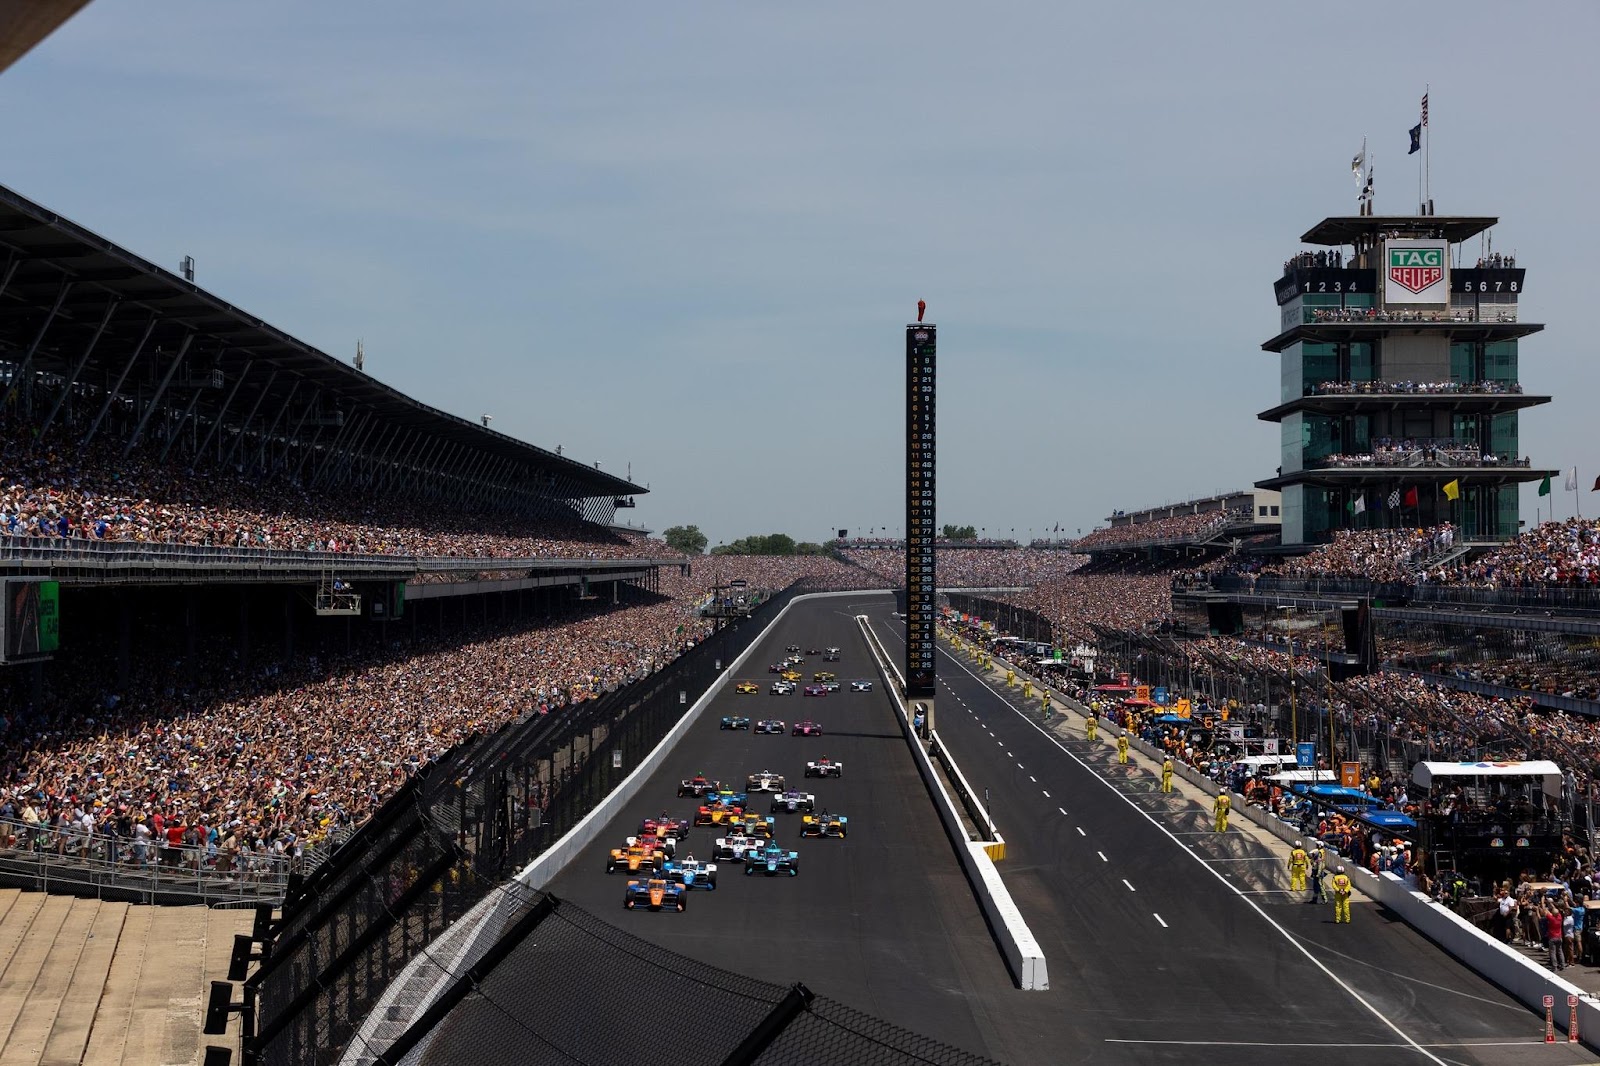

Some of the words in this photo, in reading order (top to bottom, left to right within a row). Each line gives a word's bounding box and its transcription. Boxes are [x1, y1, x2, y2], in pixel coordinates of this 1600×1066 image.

[1393, 251, 1438, 265] TAG
[1392, 268, 1440, 290] HEUER
[1304, 282, 1310, 292] 1
[1319, 282, 1326, 292] 2
[1334, 282, 1341, 292] 3
[1349, 282, 1356, 292] 4
[1465, 282, 1472, 292] 5
[1480, 282, 1487, 292] 6
[1495, 282, 1502, 292] 7
[1510, 282, 1518, 292] 8
[1181, 704, 1187, 714] 7
[1204, 716, 1213, 729] 5
